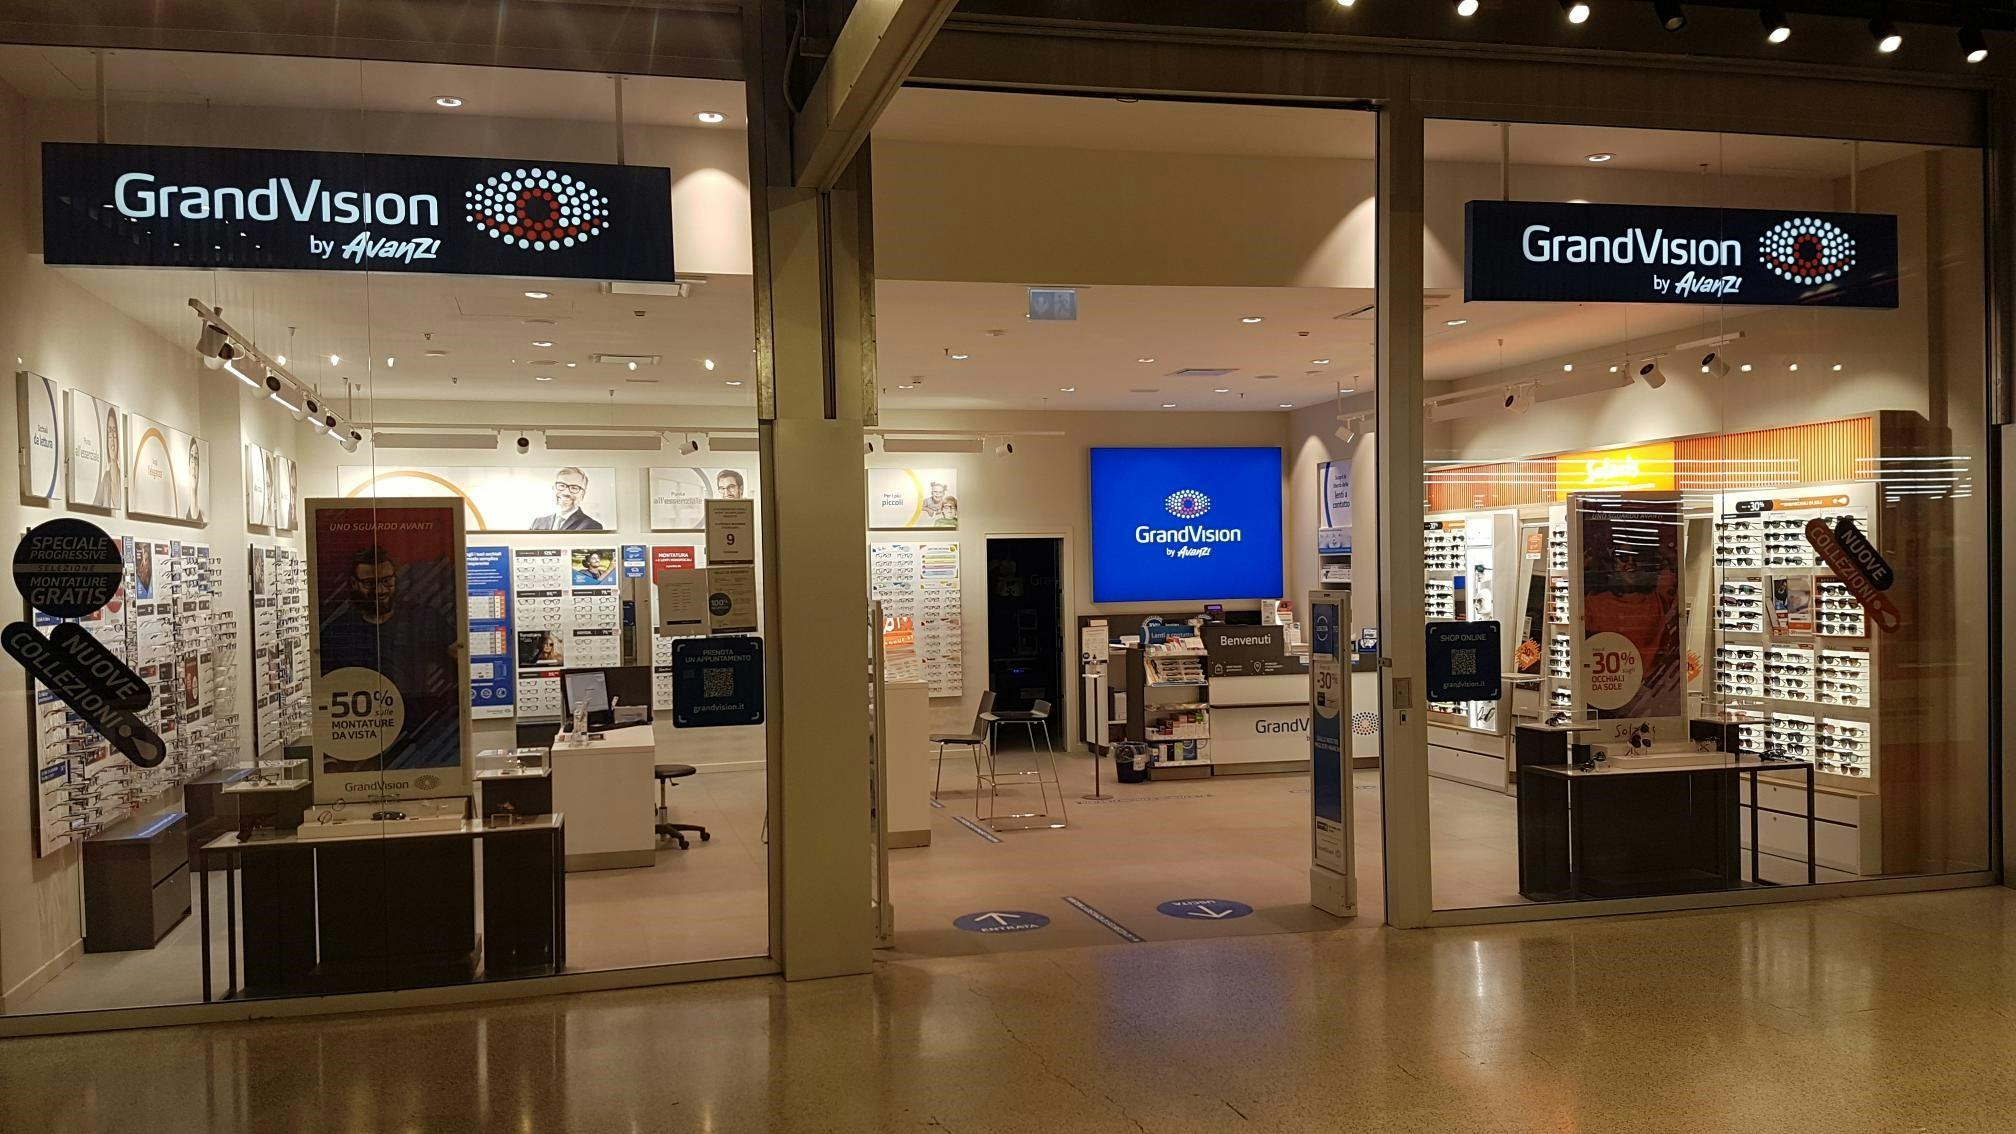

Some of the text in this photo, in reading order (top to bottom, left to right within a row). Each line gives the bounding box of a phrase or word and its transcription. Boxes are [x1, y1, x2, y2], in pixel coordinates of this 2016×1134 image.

[114, 172, 439, 226] GrandVision
[310, 235, 334, 259] by
[1522, 225, 1741, 266] GrandVision
[1653, 274, 1670, 295] by
[653, 497, 703, 505] all'essenziale
[330, 522, 433, 532] UNO SGUARDO AVANTI
[726, 534, 735, 546] 9
[1135, 525, 1241, 543] GrandVision
[31, 536, 108, 550] SPECIALE
[30, 550, 107, 560] PROGRESSIVE
[1166, 548, 1175, 558] by
[1841, 529, 1888, 581] NUOVE
[38, 564, 96, 572] SELEZIONE
[1810, 527, 1877, 601] COLLEZIONI
[30, 576, 108, 587] MONTATURE
[31, 587, 107, 606] GRATIS
[1220, 633, 1271, 646] Benvenuti
[1440, 633, 1488, 642] SHOP ONLINE
[697, 654, 752, 663] APPUNTAMENTO
[1583, 651, 1635, 675] -30%
[61, 634, 140, 700] NUOVE
[10, 632, 124, 729] COLLEZIONI
[1443, 680, 1485, 690] grandvision.it
[1591, 675, 1625, 683] OCCHIALI
[1604, 683, 1622, 691] SOLE
[318, 689, 394, 719] -50%
[693, 702, 745, 713] grandvision.it
[331, 718, 395, 729] MONTATURE
[1255, 717, 1310, 734] GrandV
[332, 729, 377, 740] DA VISTA
[344, 780, 410, 792] GrandVision
[980, 924, 1041, 932] ENTRATA
